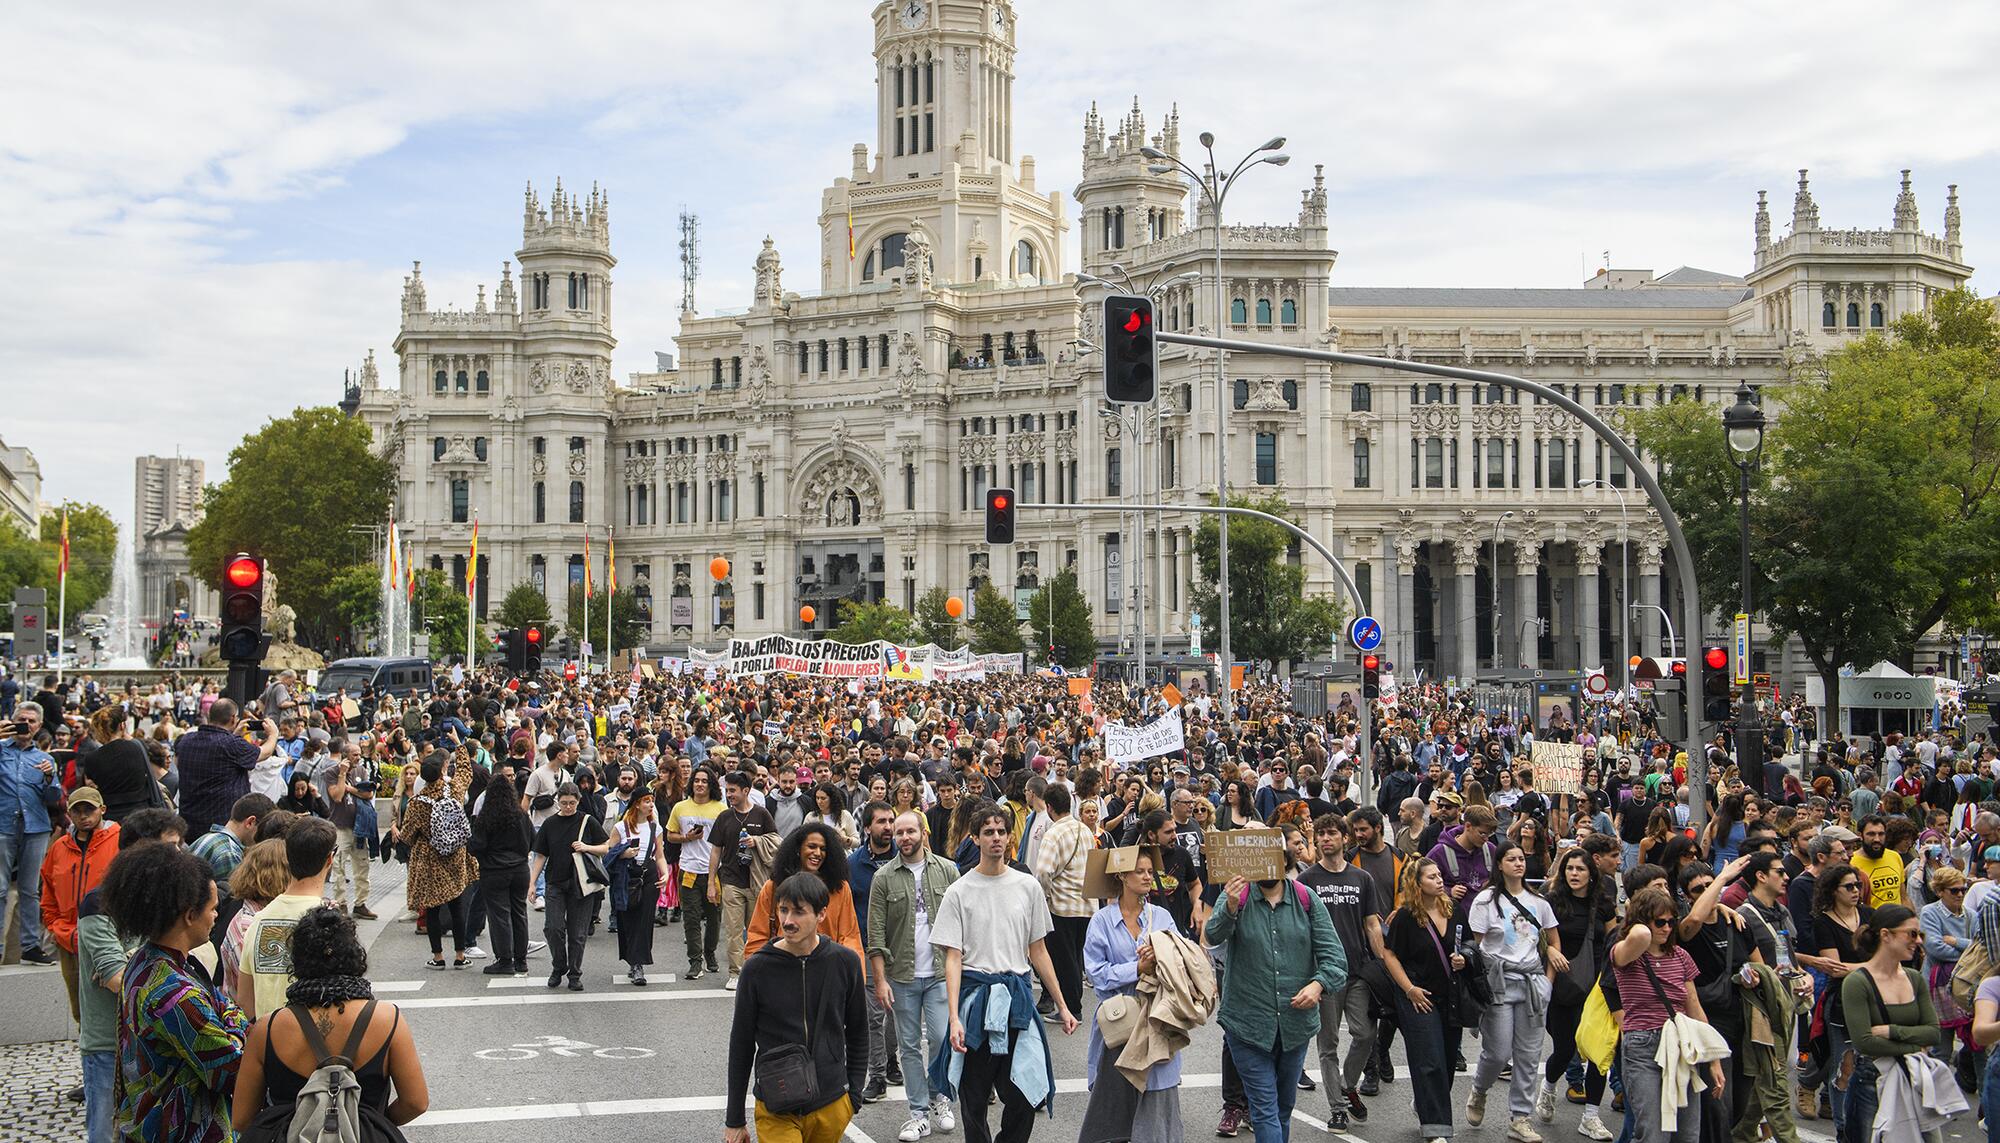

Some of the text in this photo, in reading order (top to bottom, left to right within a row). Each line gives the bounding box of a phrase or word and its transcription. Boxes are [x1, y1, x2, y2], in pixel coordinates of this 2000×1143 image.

[731, 636, 880, 661] BAJEMOS LOS PRECIOS
[733, 661, 740, 674] A
[741, 659, 761, 673] POR
[762, 657, 774, 671] LA
[775, 656, 809, 673] HUELGA
[809, 662, 822, 674] DE
[822, 662, 880, 676] ALQUILERES
[1108, 739, 1132, 756] PISO
[1209, 835, 1222, 847] EL
[1218, 848, 1265, 857] ENMASCARA
[1211, 857, 1274, 867] EL FEUDALISMO
[1872, 876, 1899, 889] STOP
